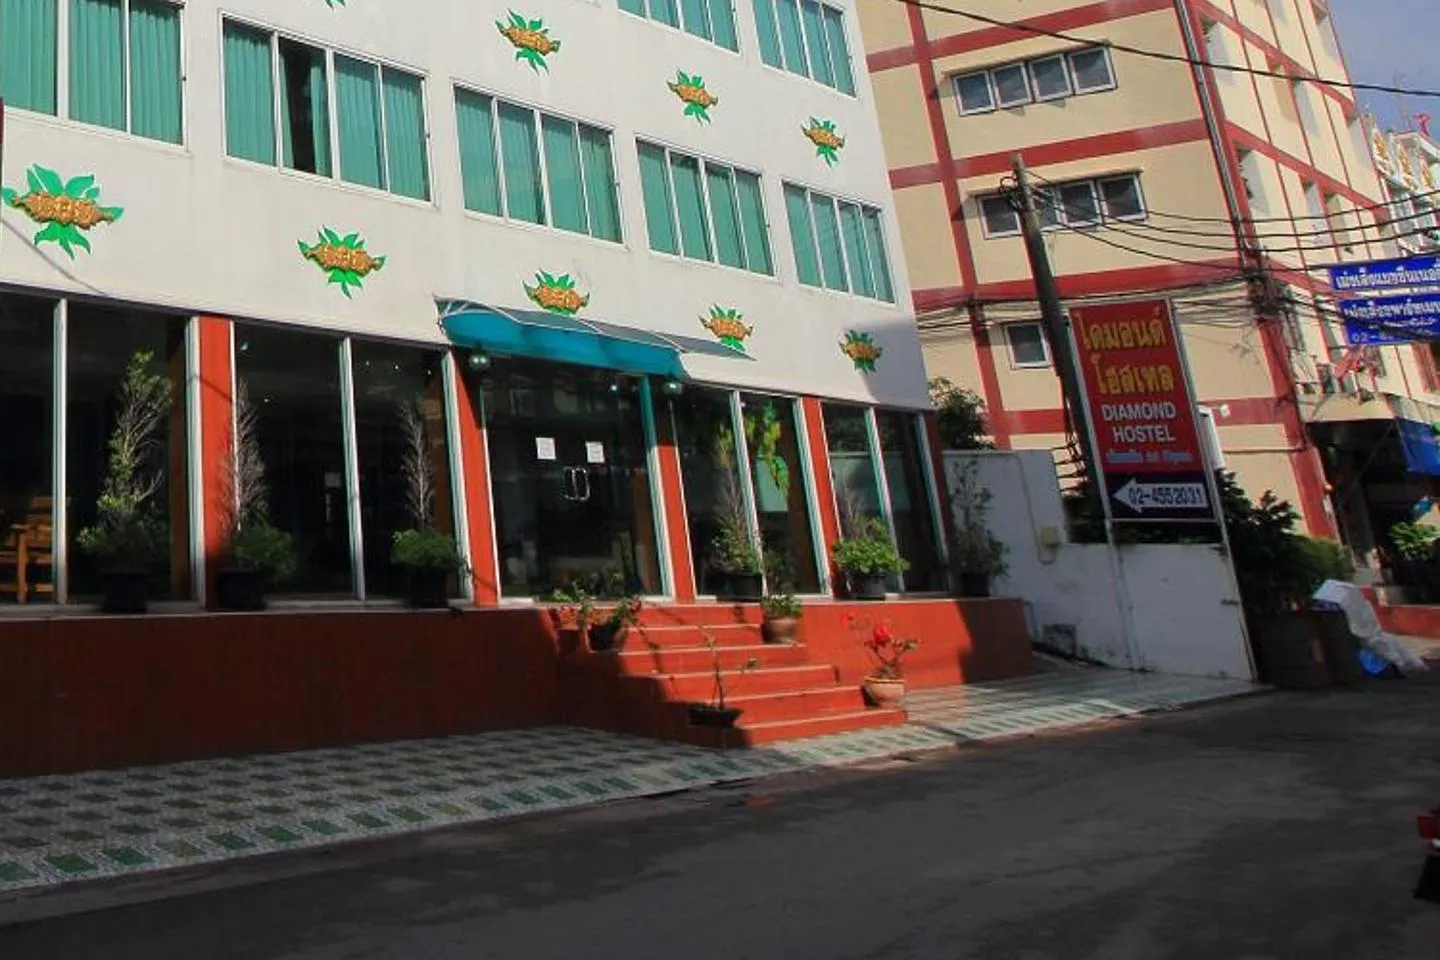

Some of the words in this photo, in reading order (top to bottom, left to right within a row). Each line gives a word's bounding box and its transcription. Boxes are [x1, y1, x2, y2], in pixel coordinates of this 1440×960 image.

[1072, 307, 1167, 350] ไดมอนด์
[1101, 402, 1176, 421] DIAMOND
[1112, 425, 1177, 443] HOSTEL
